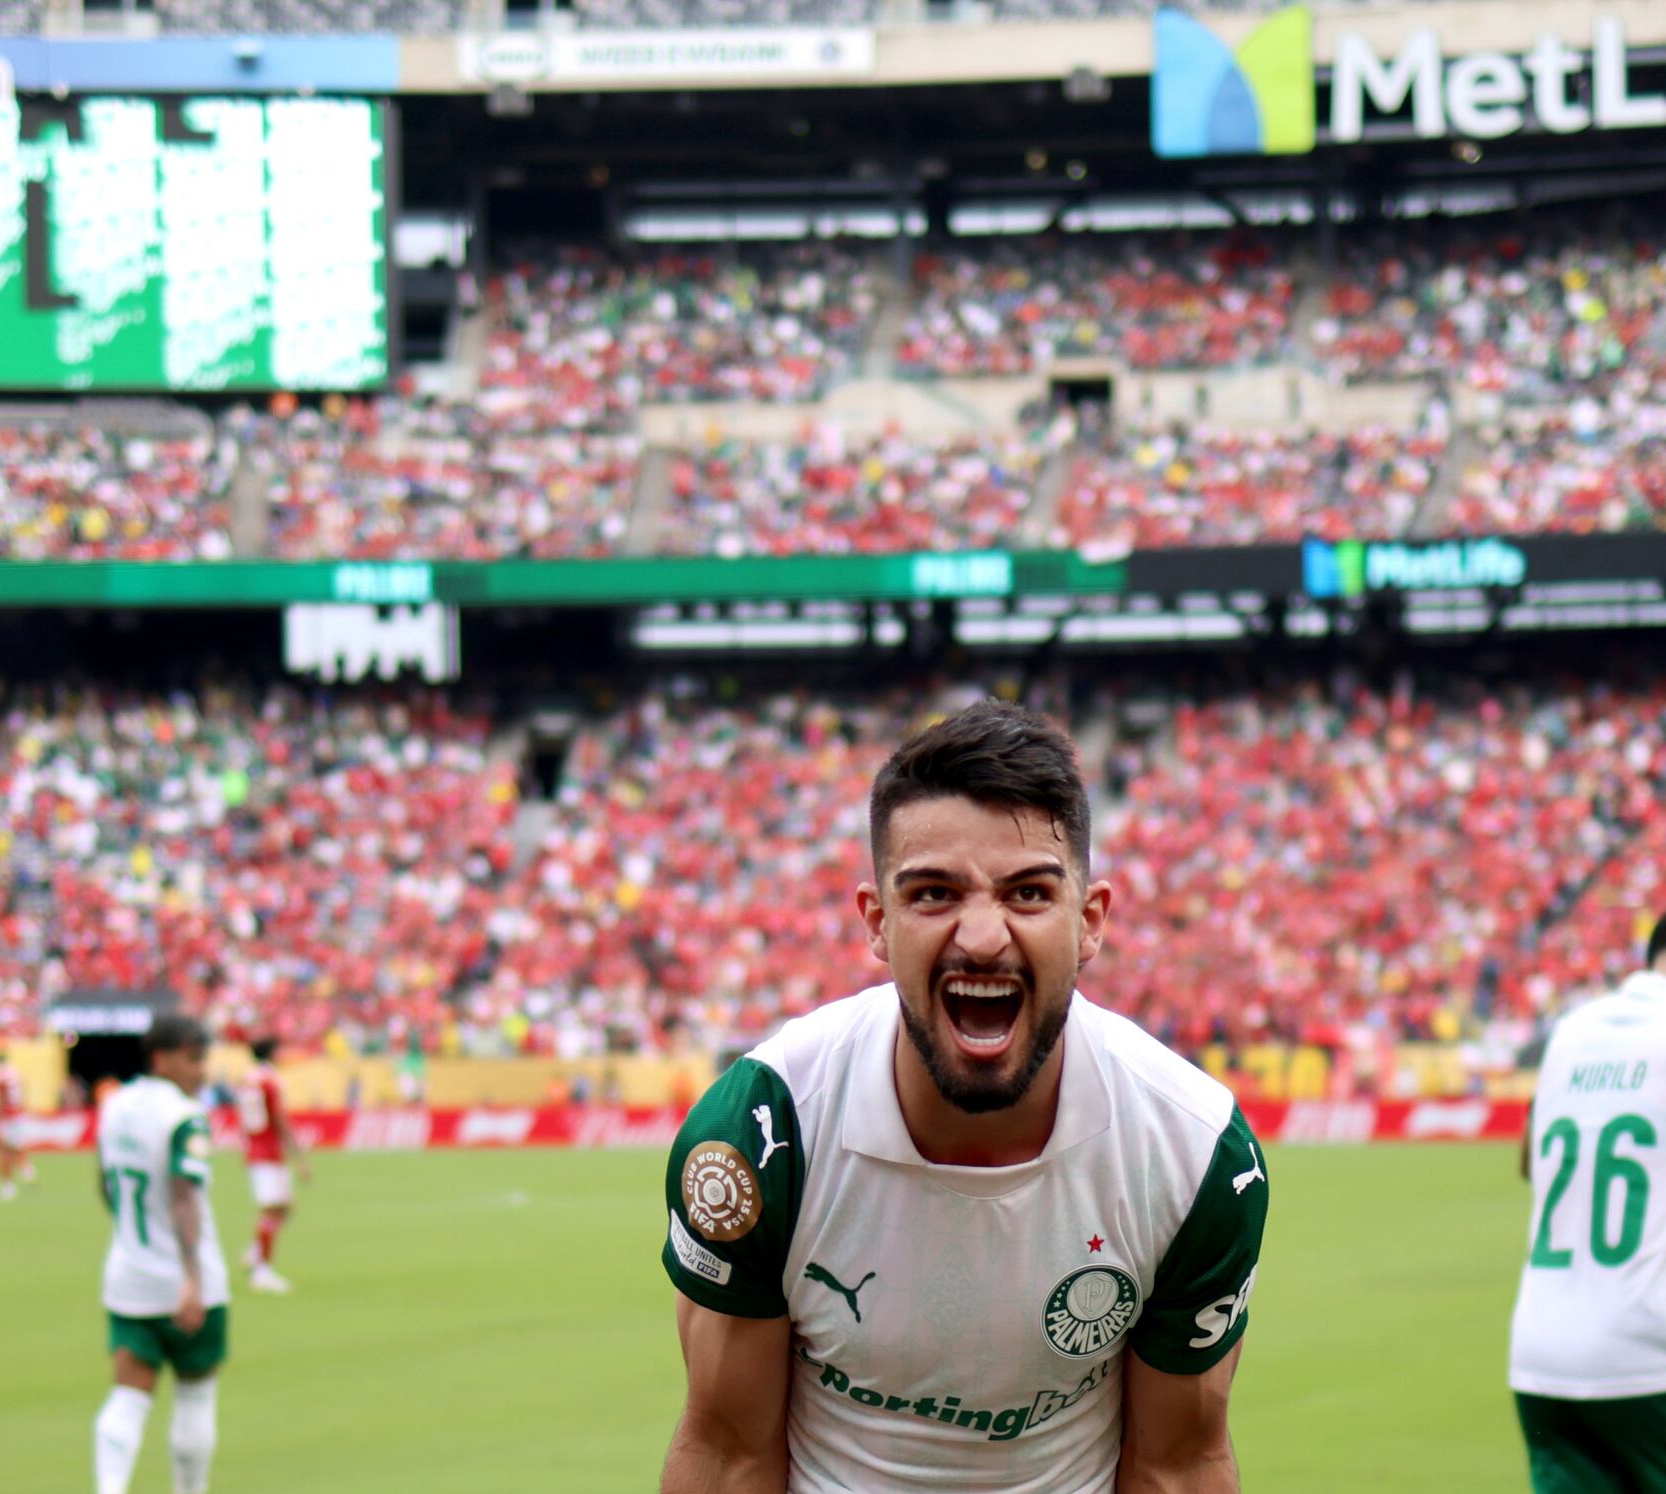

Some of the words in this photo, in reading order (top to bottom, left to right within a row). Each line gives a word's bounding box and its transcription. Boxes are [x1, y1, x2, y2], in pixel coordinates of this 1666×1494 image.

[1365, 535, 1528, 590] MetLife
[1568, 1059, 1650, 1093] MURILO
[686, 1161, 698, 1195] CLUB
[697, 1151, 737, 1169] WORLD
[736, 1169, 753, 1196] CUP
[1530, 1112, 1658, 1269] 26
[688, 1202, 717, 1234] FIFA
[1047, 1300, 1135, 1354] PALMEIRAS
